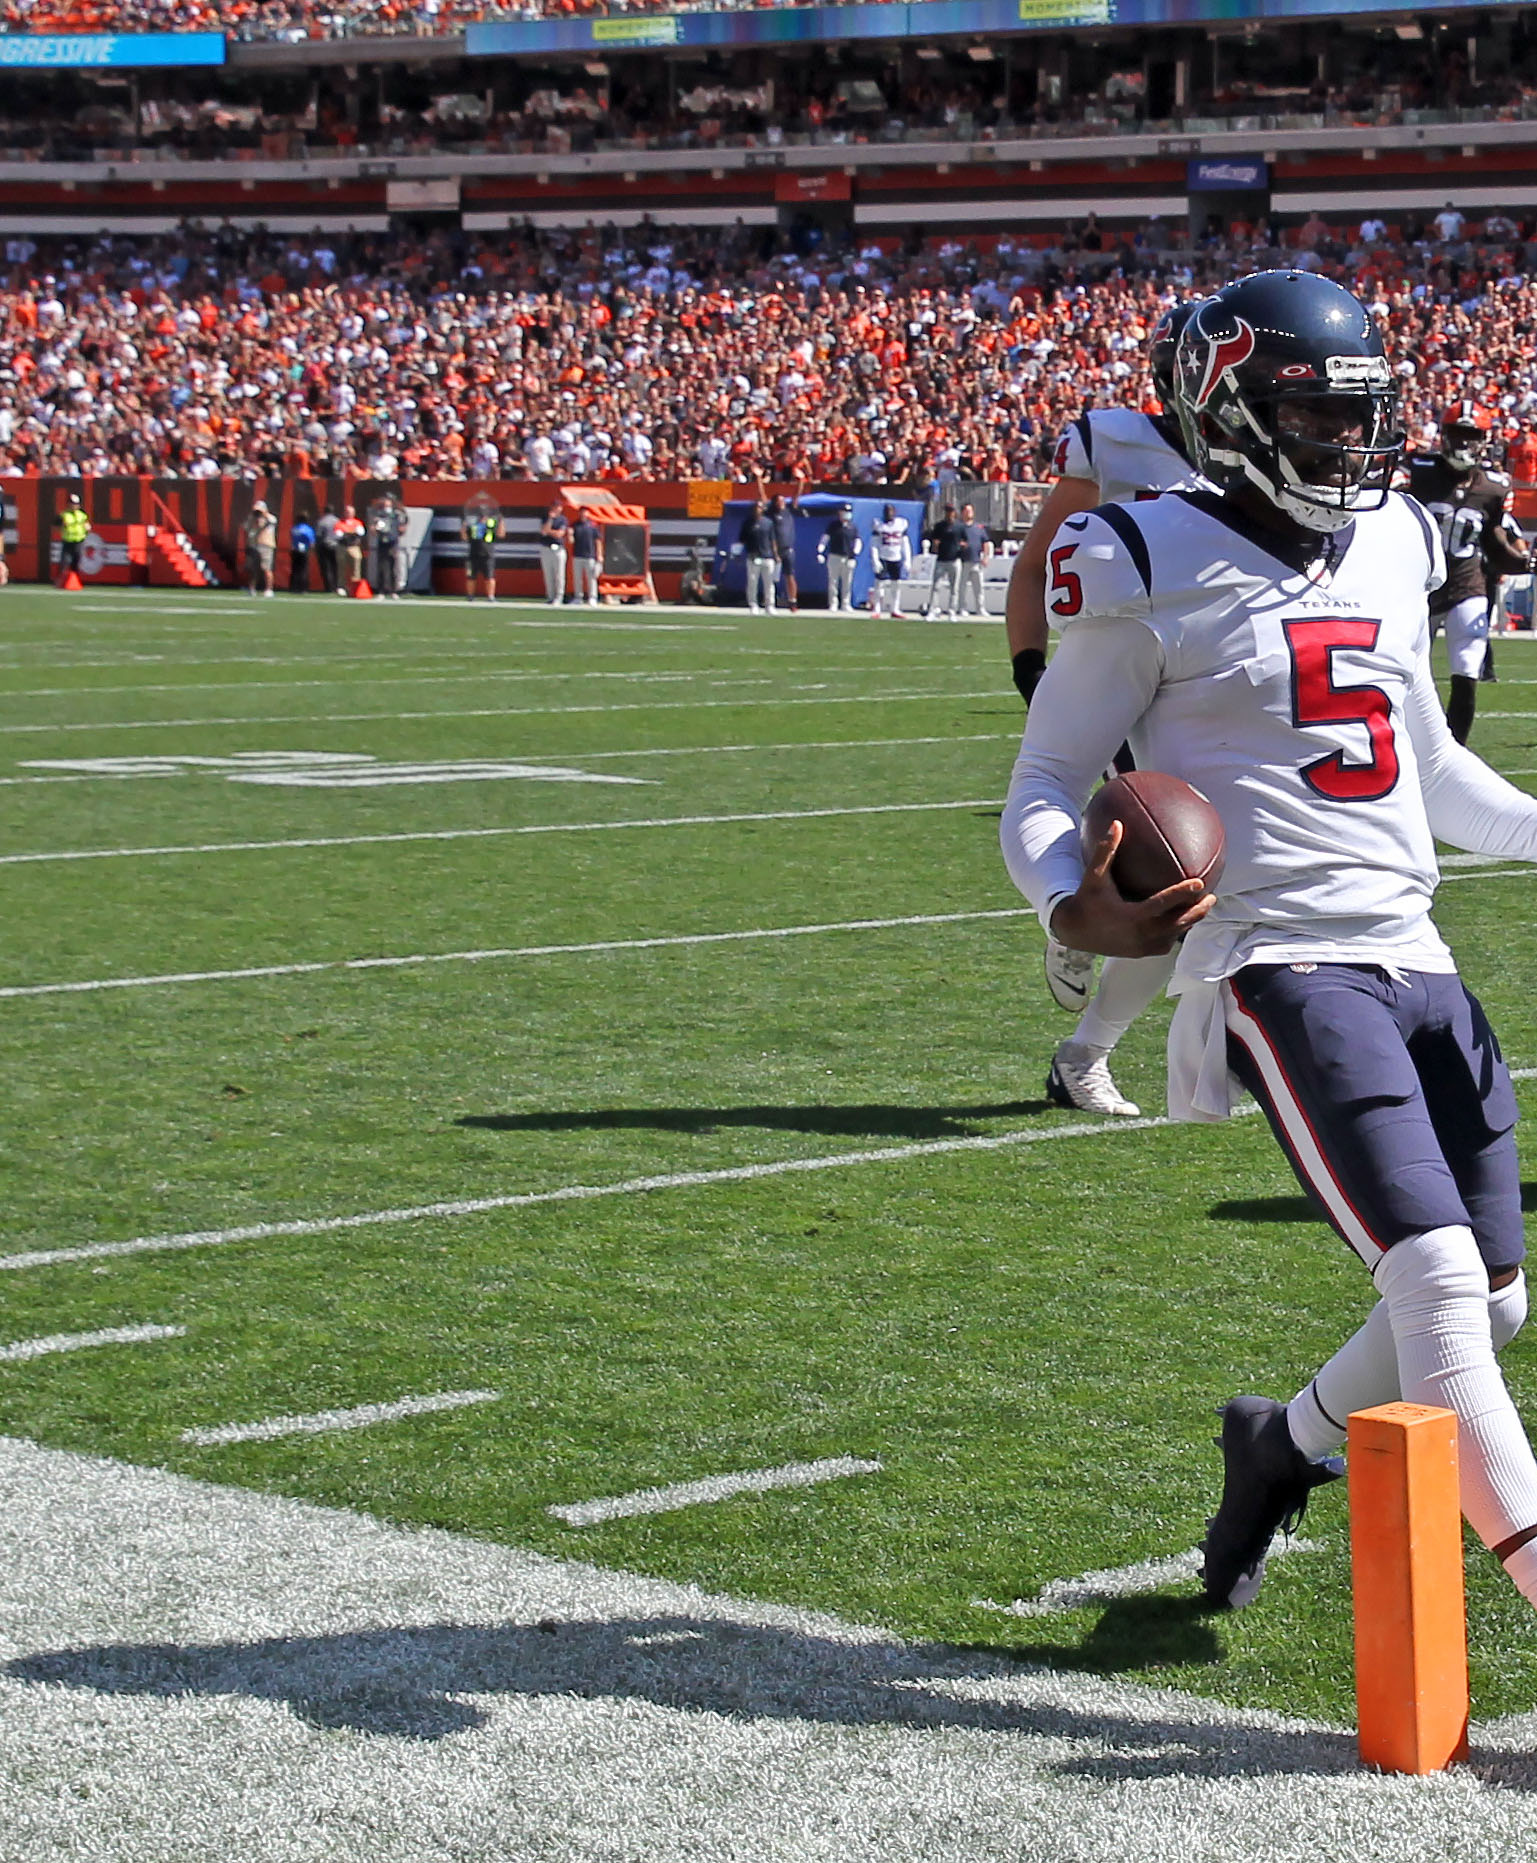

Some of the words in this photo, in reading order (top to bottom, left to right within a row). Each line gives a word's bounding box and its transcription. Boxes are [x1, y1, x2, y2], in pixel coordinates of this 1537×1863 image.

[1051, 543, 1083, 617] 5
[1299, 600, 1361, 610] TEXANS
[1279, 615, 1400, 803] 5
